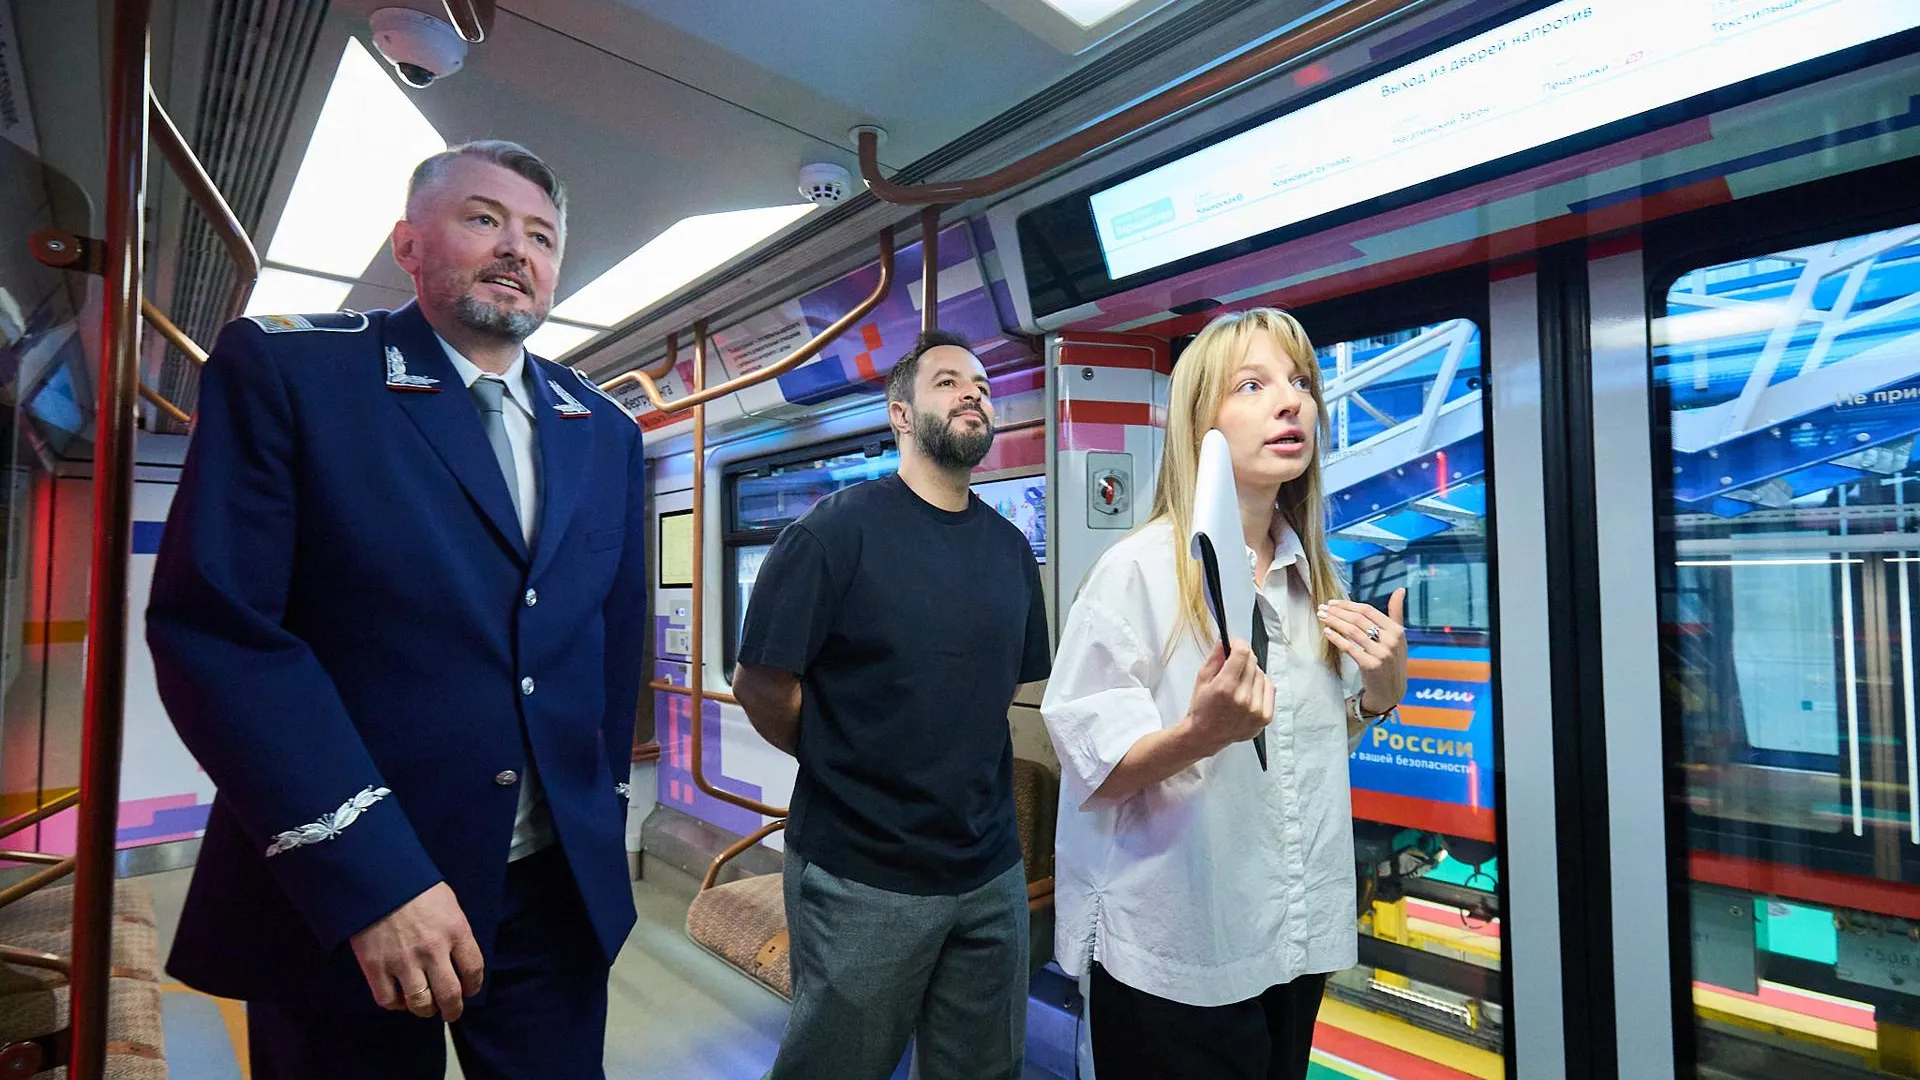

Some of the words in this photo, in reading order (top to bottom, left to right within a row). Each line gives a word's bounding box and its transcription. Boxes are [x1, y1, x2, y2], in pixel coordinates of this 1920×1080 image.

[1381, 73, 1426, 97] Выход
[1430, 65, 1446, 78] из
[1450, 39, 1507, 71] дверей
[1512, 7, 1593, 46] напротив
[1542, 64, 1609, 94] Печатники
[1835, 392, 1868, 407] Не
[1874, 387, 1920, 404] при
[1373, 727, 1473, 758] России
[1359, 752, 1393, 764] вашей
